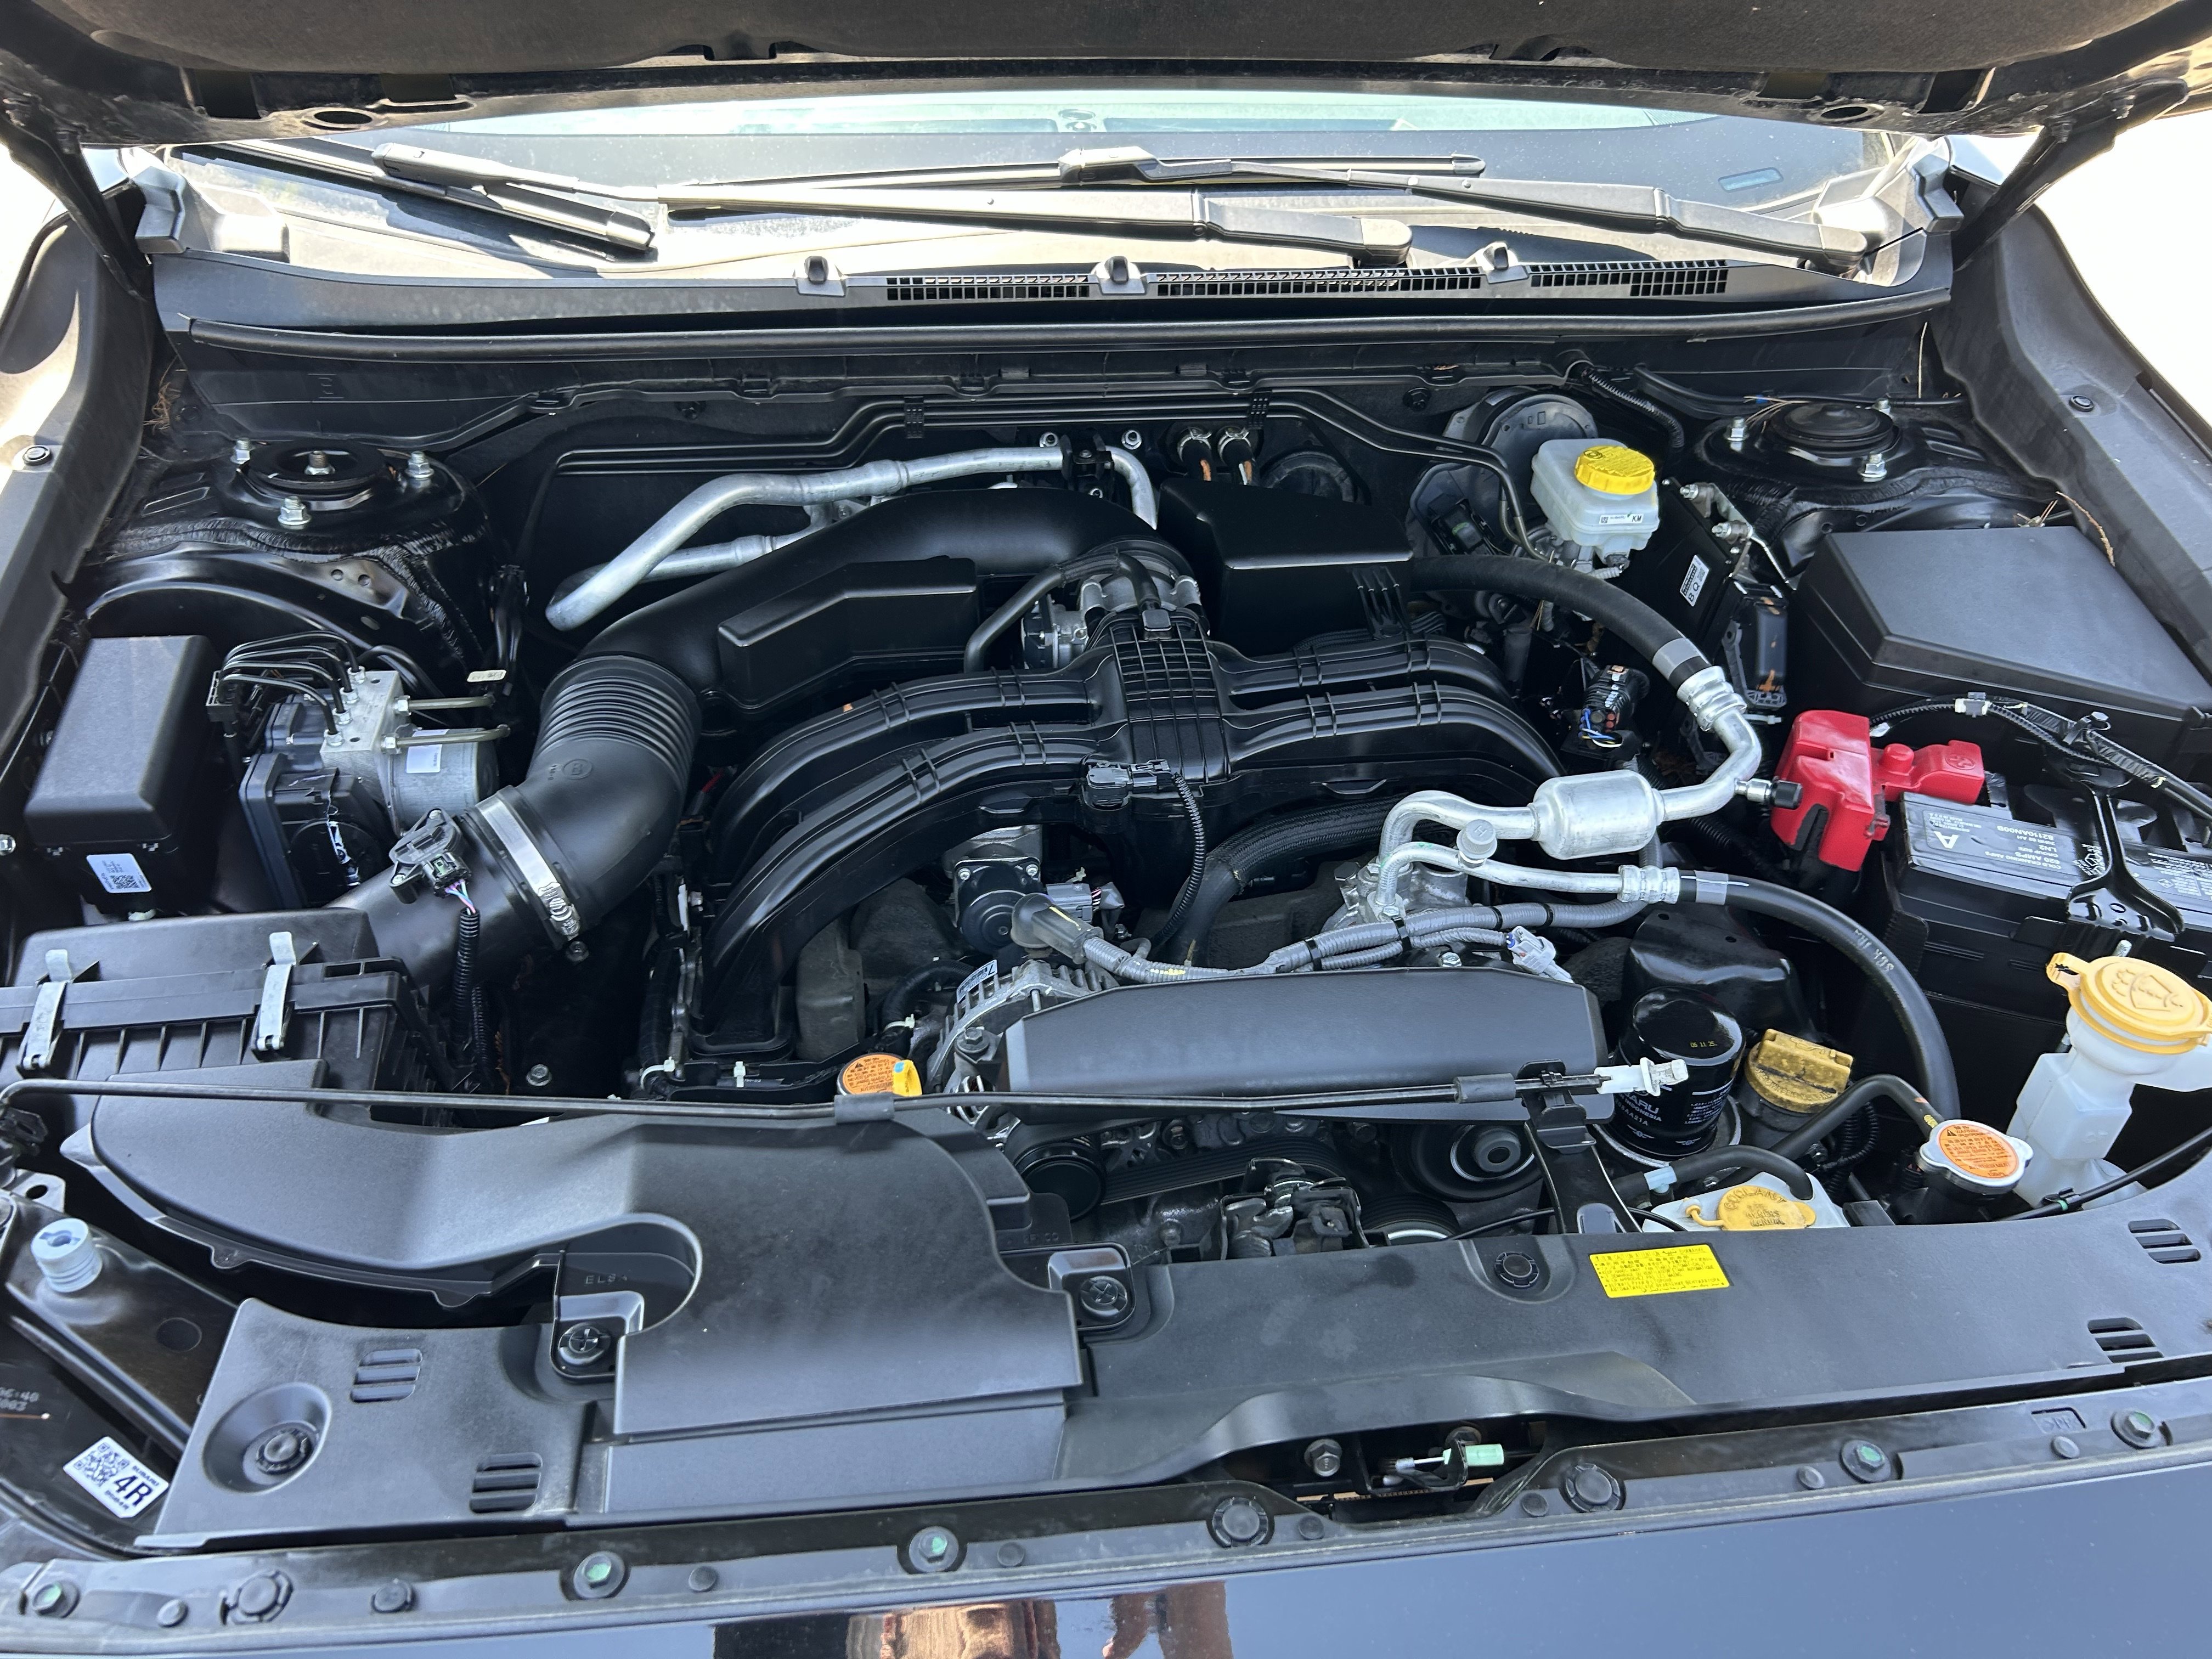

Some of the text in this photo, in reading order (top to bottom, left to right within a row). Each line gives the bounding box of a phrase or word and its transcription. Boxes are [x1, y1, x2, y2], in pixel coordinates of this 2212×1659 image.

[1474, 825, 1487, 837] H
[1933, 831, 1959, 849] A
[2038, 844, 2057, 853] LN2
[2005, 855, 2041, 866] CRANKING
[2014, 851, 2061, 865] 620 AMPS
[1625, 1098, 1662, 1122] INDONESIA
[1724, 1187, 1787, 1209] COOLANT
[113, 1472, 152, 1508] 4R
